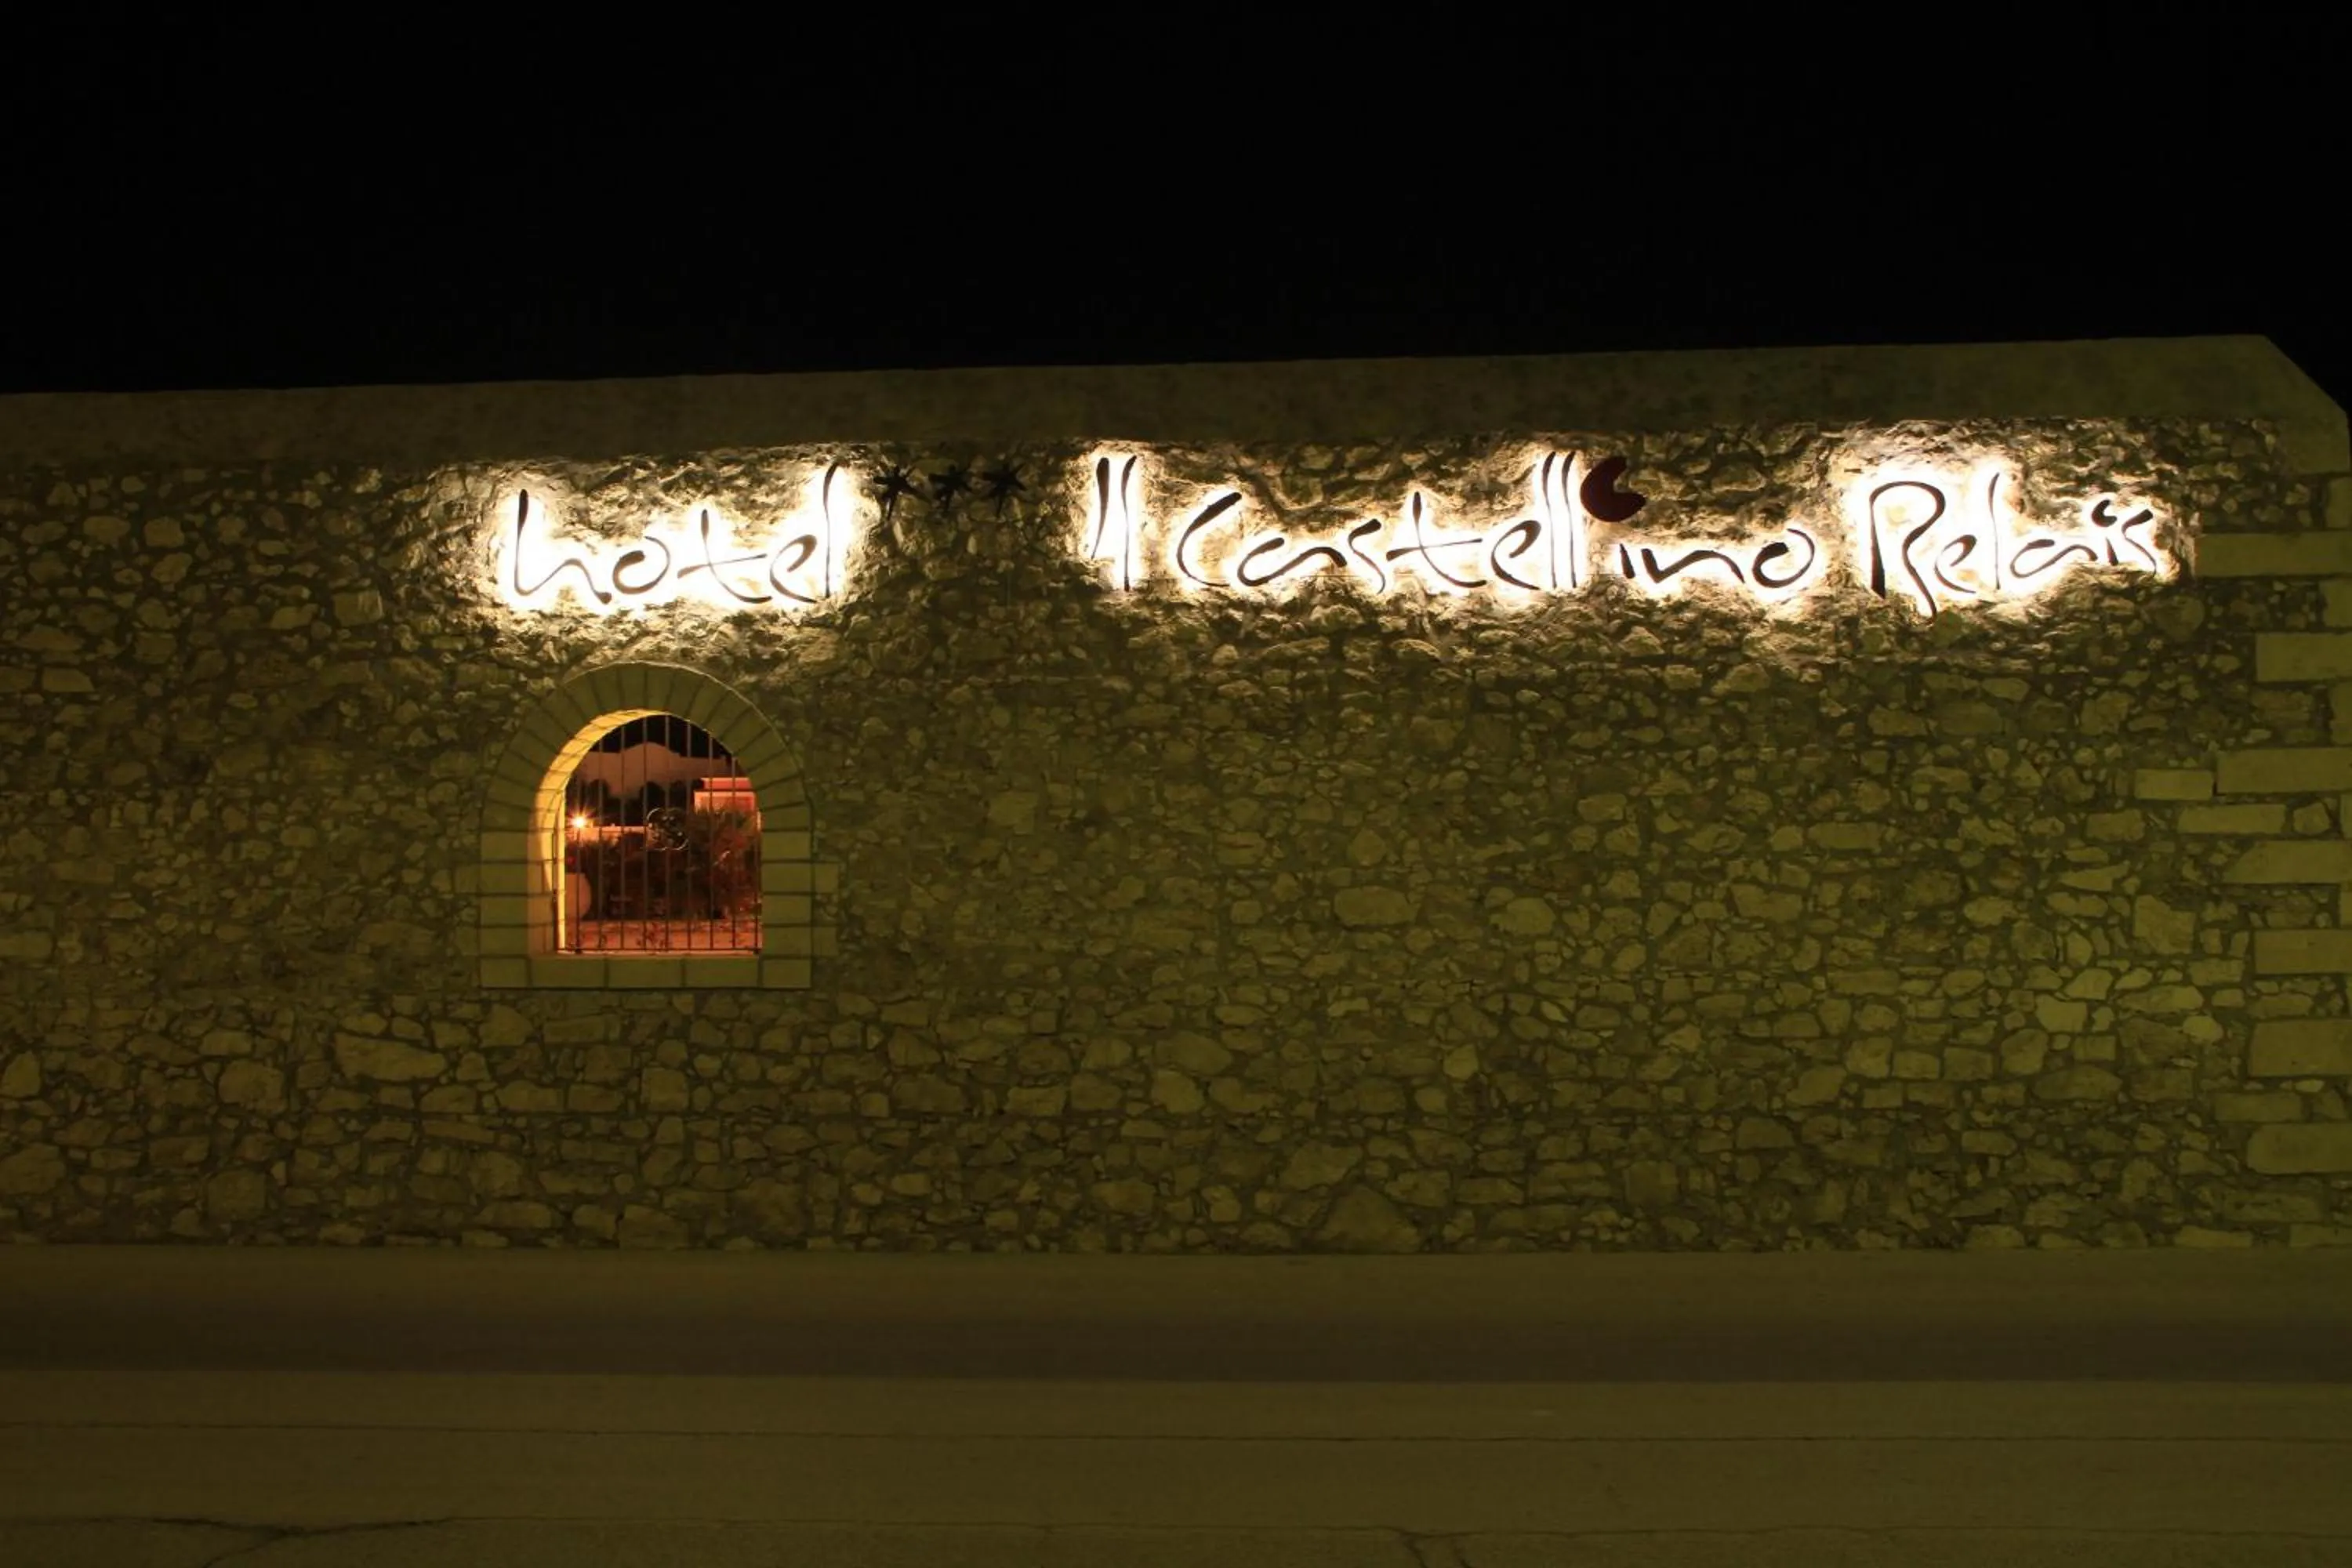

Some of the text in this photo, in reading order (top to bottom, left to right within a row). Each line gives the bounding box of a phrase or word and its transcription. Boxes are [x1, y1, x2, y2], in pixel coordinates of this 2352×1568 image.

[513, 462, 840, 605] hotel
[1177, 451, 1815, 595] Castellino
[1870, 472, 2154, 619] Relais
